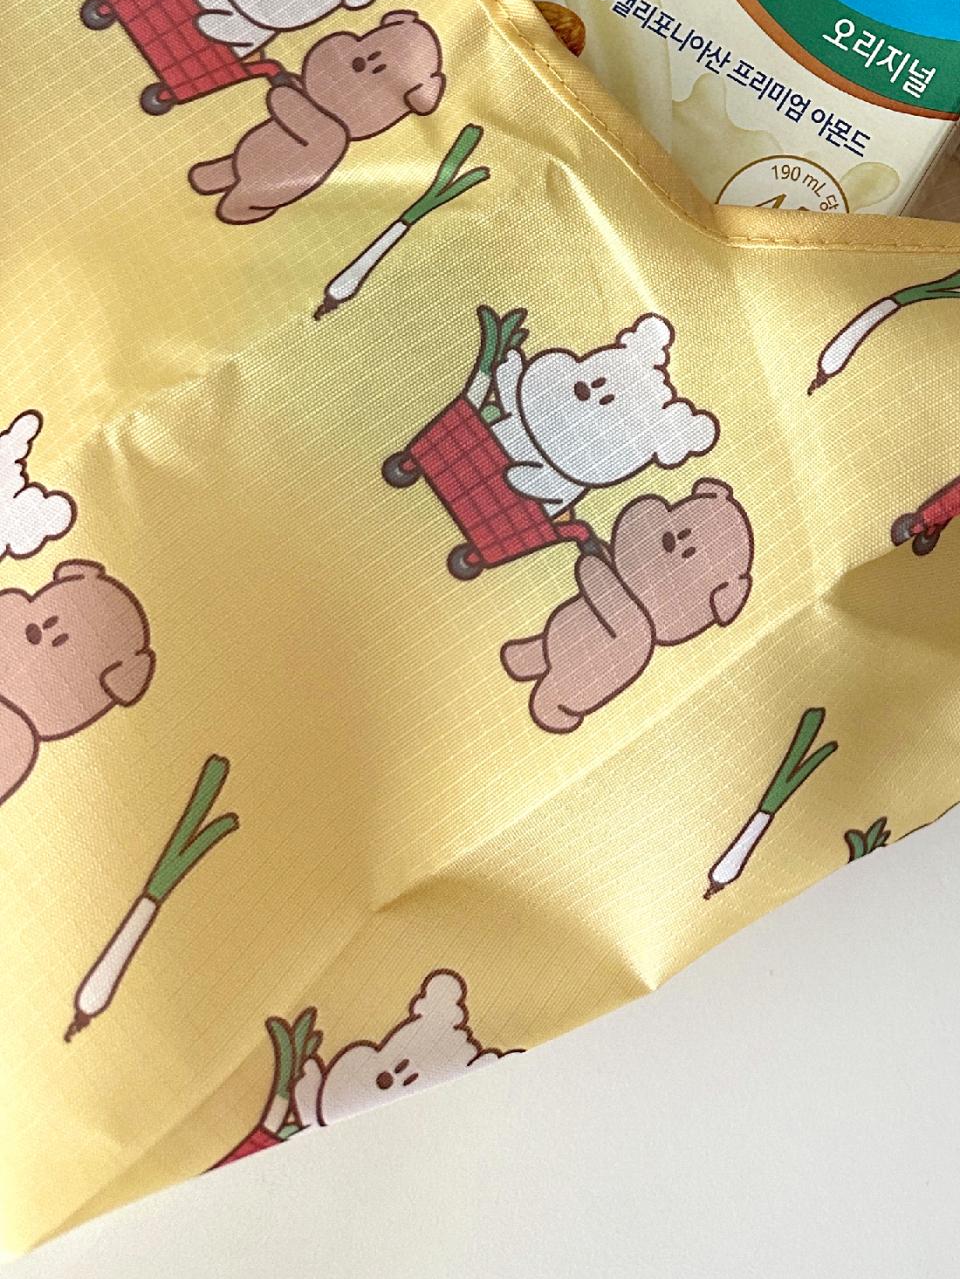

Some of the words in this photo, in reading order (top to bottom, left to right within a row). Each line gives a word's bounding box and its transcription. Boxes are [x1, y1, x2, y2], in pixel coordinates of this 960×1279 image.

[823, 18, 937, 100] 오리지널
[725, 61, 811, 122] 프리미엄
[811, 108, 872, 158] 아몬드
[771, 164, 801, 182] 190
[802, 174, 826, 198] mL
[819, 194, 840, 212] 당
